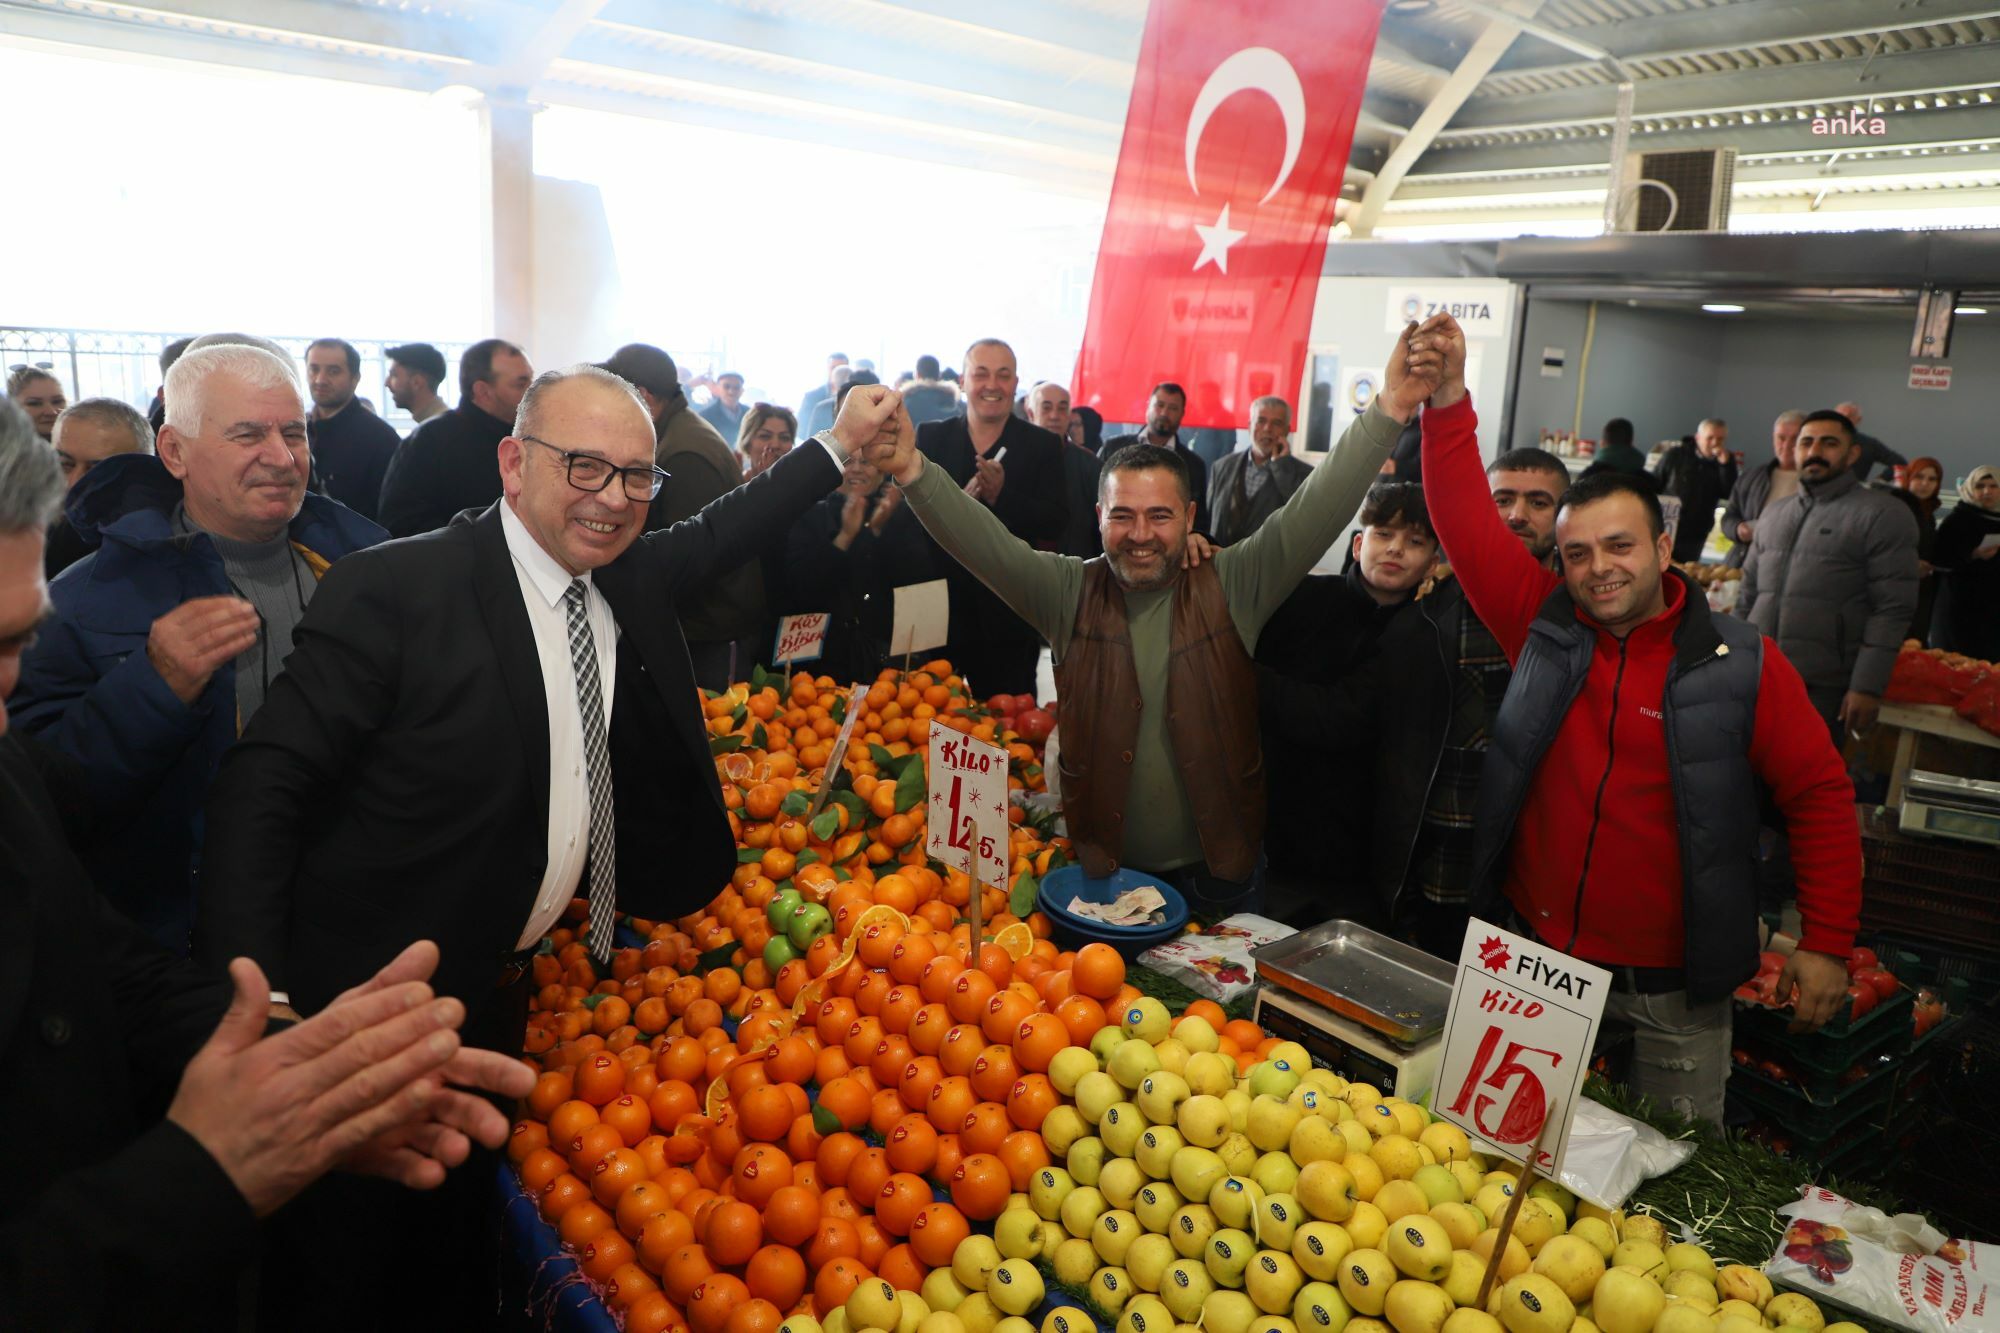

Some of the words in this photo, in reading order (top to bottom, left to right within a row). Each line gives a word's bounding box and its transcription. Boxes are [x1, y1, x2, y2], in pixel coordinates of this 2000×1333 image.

[1425, 303, 1490, 319] ZABITA
[1483, 944, 1507, 960] İNDİRİM
[1516, 955, 1592, 1000] FİYAT
[1446, 1025, 1563, 1144] 15
[1923, 1262, 1945, 1308] MİNİ
